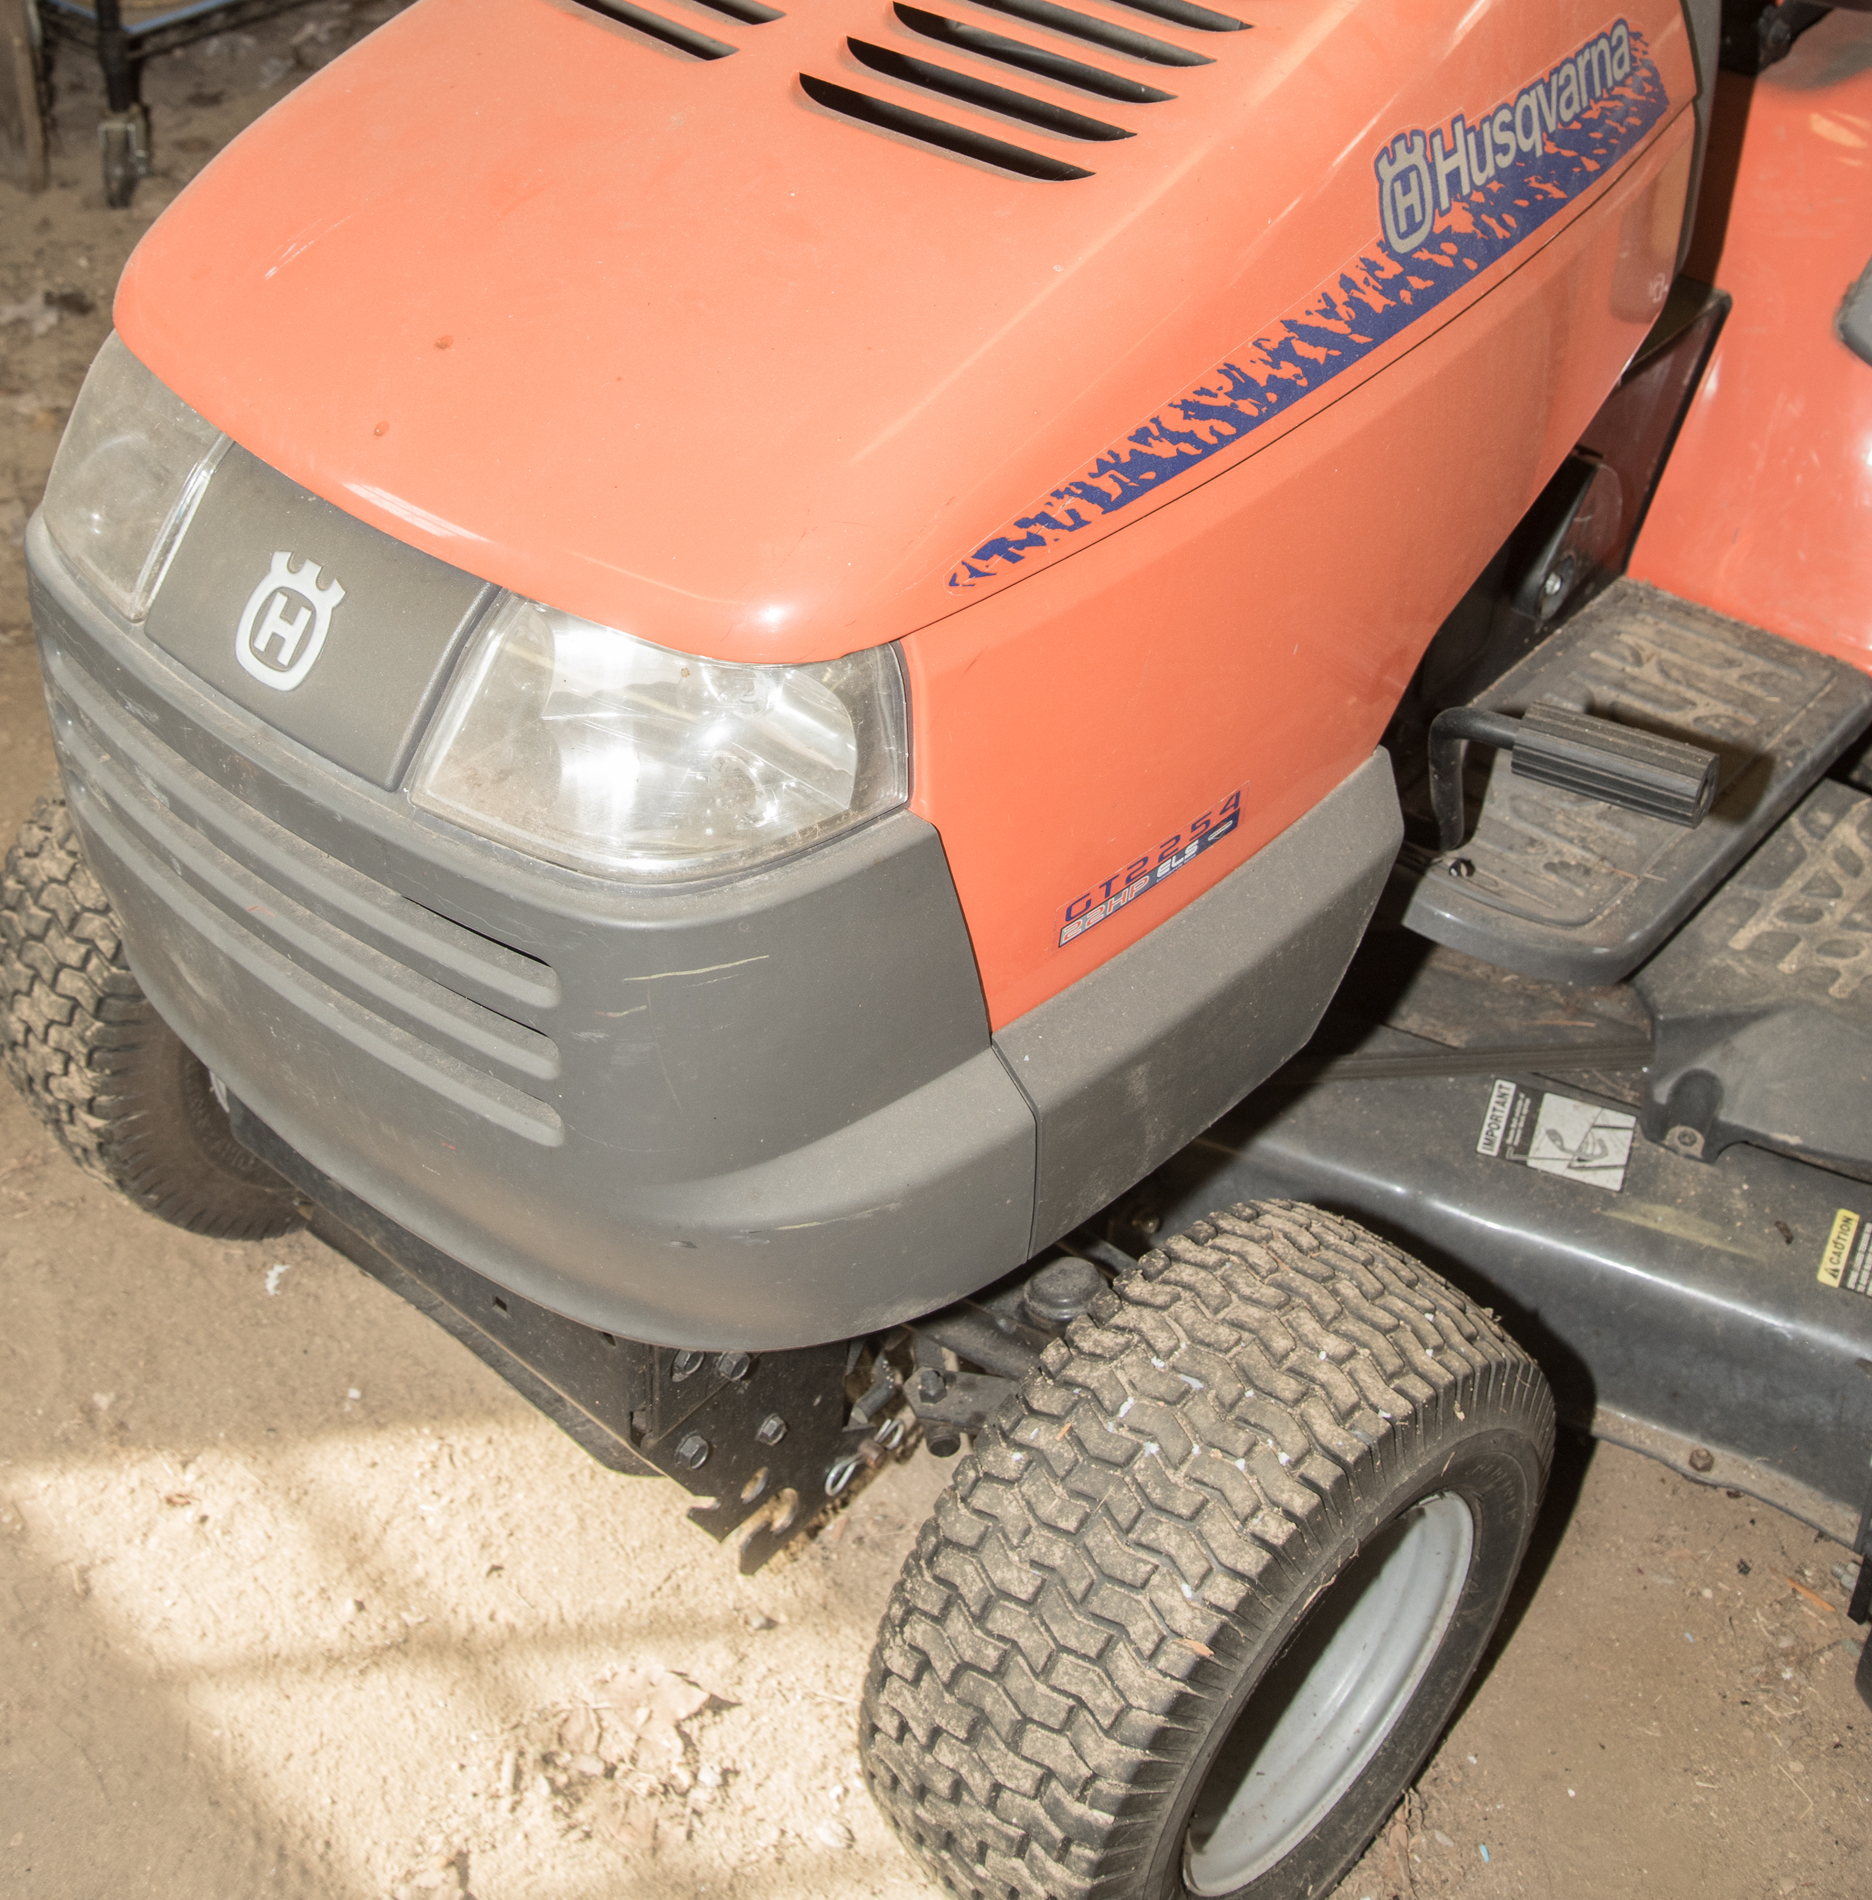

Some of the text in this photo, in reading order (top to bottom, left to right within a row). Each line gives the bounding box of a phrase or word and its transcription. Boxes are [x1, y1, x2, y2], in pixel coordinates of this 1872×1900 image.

[1432, 23, 1631, 212] Husqvarna
[1062, 874, 1150, 944] 22HP
[1156, 839, 1200, 879] ELS
[1065, 790, 1241, 922] GT2254
[1481, 1083, 1513, 1152] IMPORTANT
[1829, 1215, 1854, 1266] CAUTION
